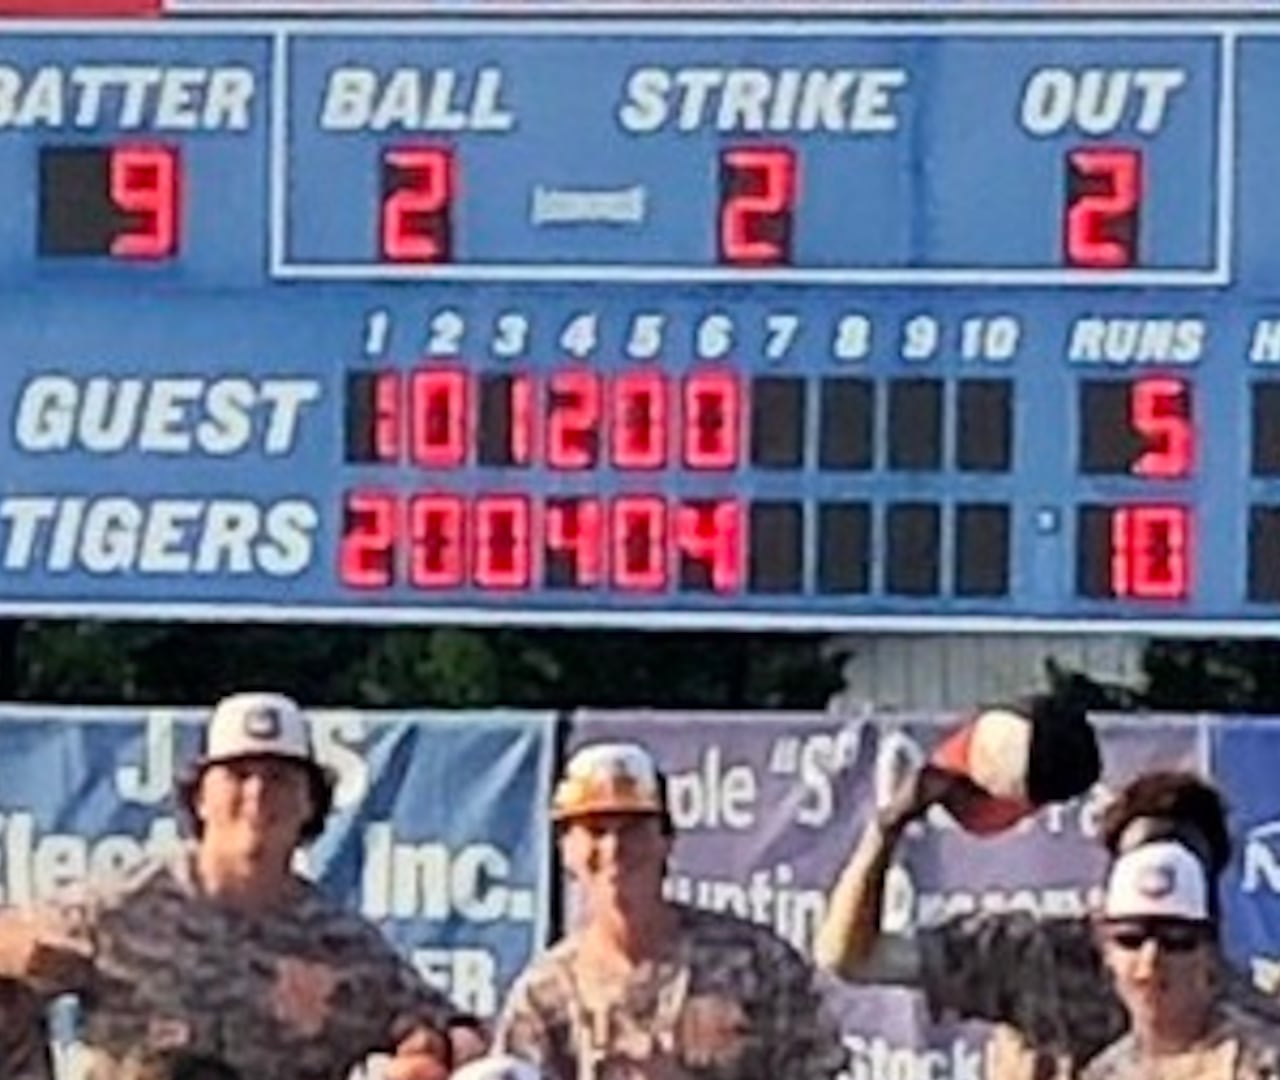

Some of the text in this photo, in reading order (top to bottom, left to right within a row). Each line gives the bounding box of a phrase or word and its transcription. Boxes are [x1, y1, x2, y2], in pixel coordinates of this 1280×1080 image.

[320, 67, 1186, 135] BALL STRIKE OUT
[108, 146, 180, 258] 9
[381, 149, 1140, 266] 2 2 2
[365, 312, 389, 355] 1
[427, 312, 465, 355] 2
[492, 313, 528, 356] 3
[559, 314, 598, 357] 4
[627, 314, 664, 358] 5
[697, 314, 733, 359] 6
[766, 314, 799, 358] 7
[834, 315, 870, 358] 8
[902, 316, 938, 359] 9
[960, 316, 1020, 360] 10
[1067, 318, 1206, 364] RUNS
[14, 375, 320, 454] GUEST
[360, 822, 534, 922] Inc.
